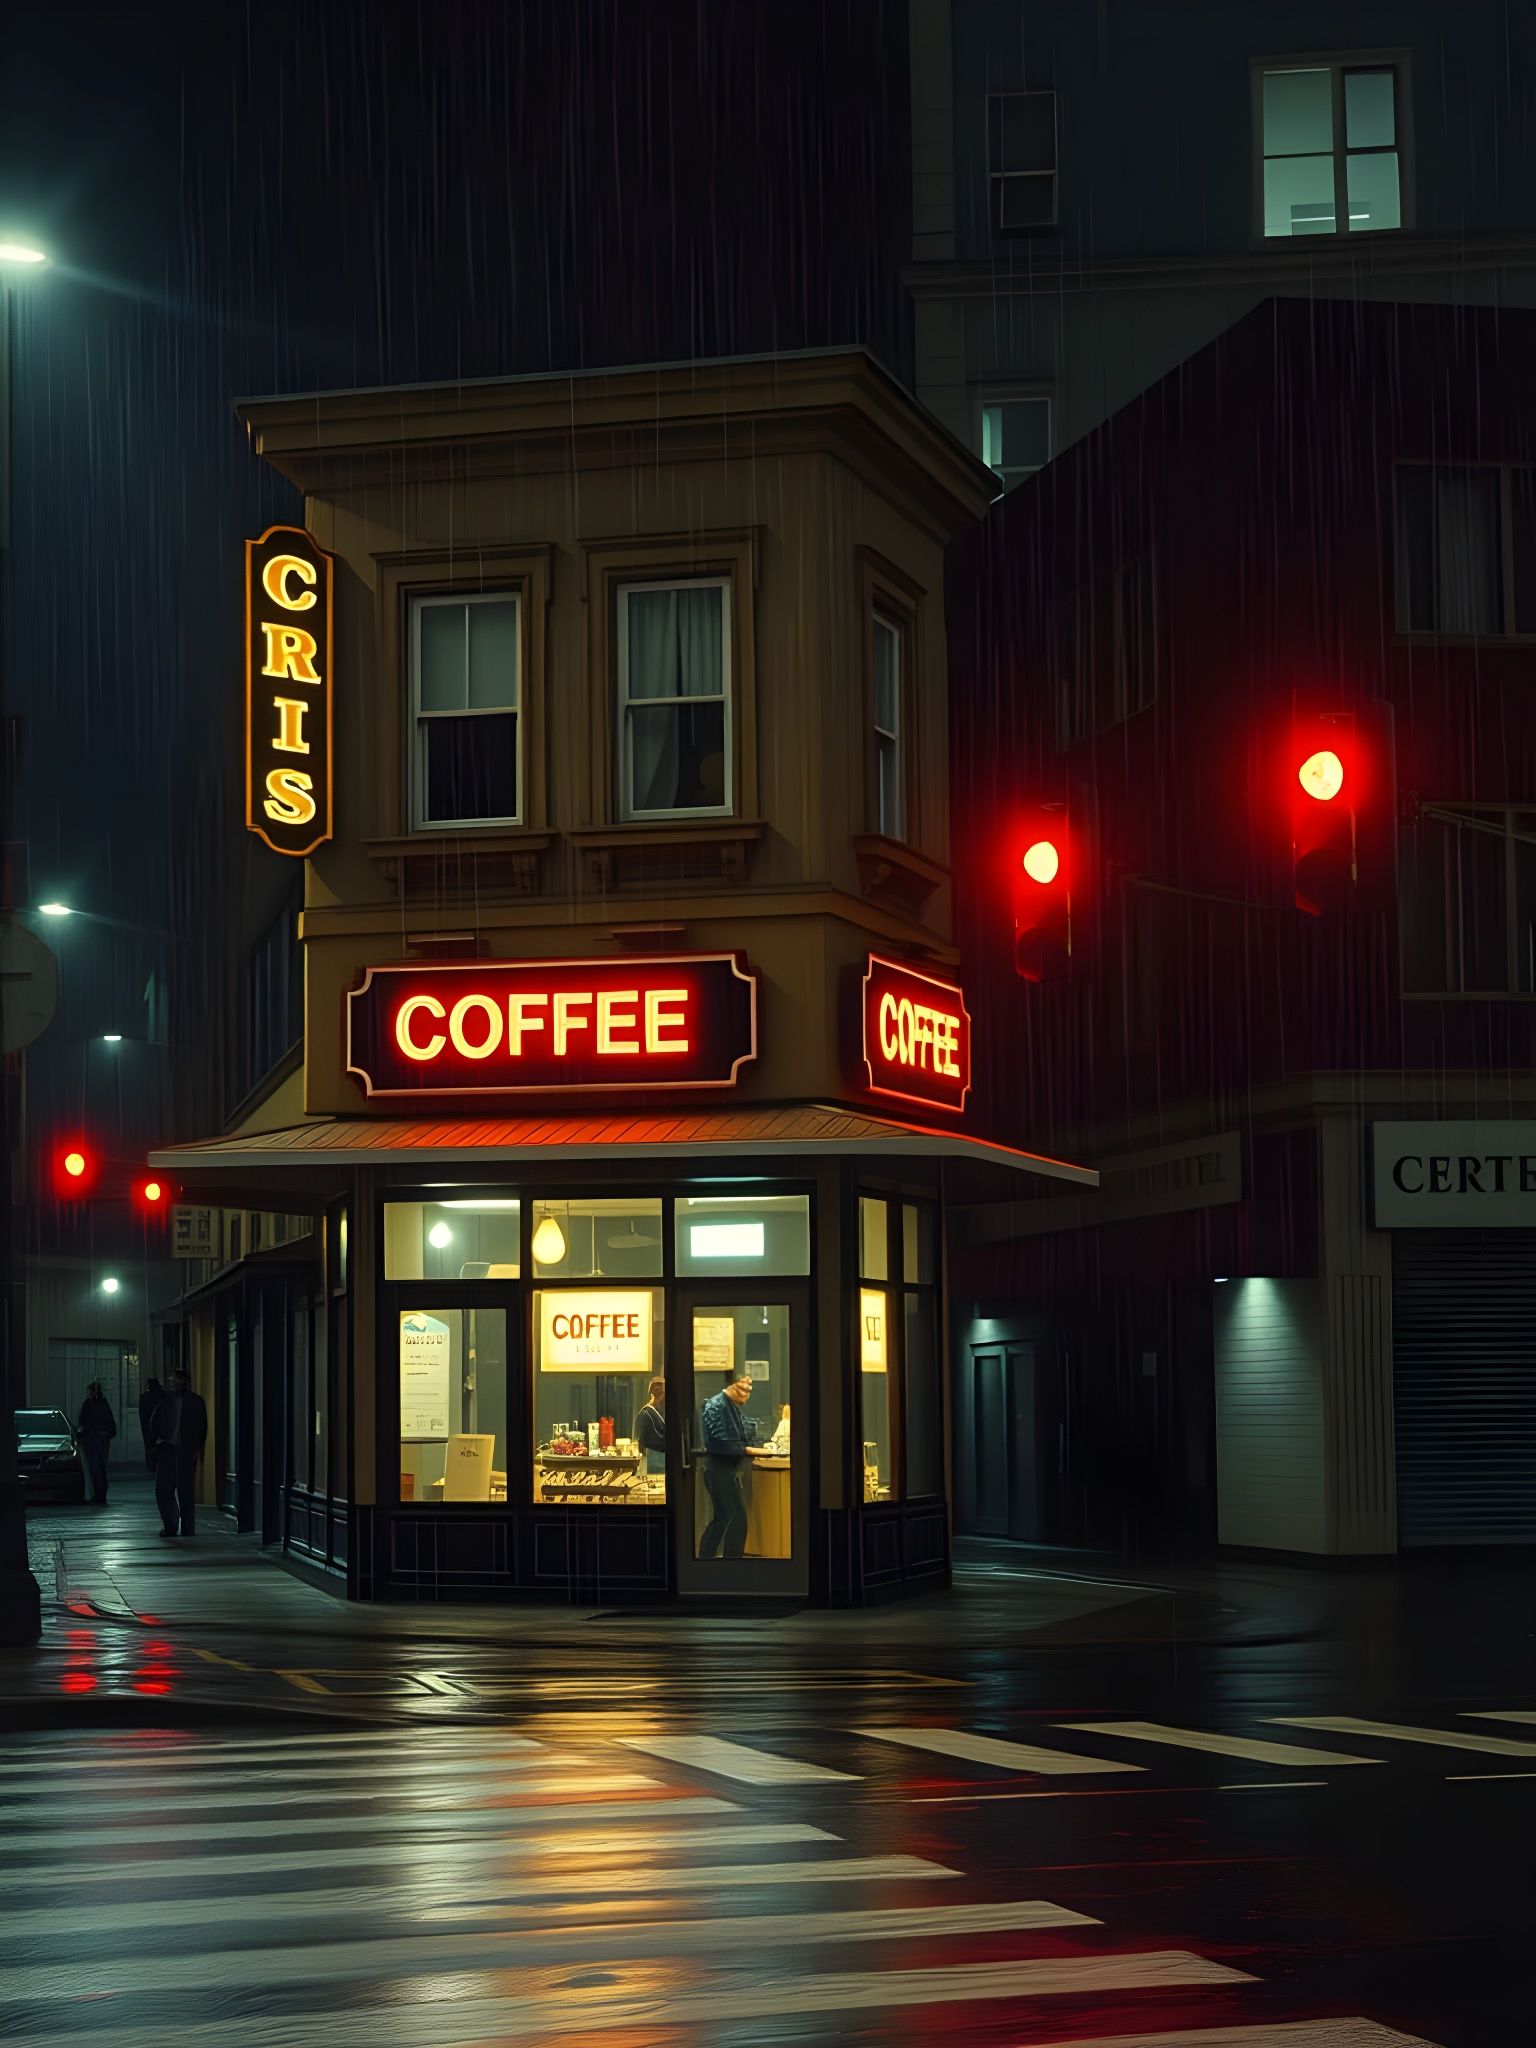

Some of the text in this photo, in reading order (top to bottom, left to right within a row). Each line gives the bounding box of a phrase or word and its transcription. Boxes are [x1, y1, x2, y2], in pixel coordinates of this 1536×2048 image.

[261, 554, 322, 825] CRIS
[395, 989, 689, 1061] COFFEE
[552, 1313, 640, 1340] COFFEE
